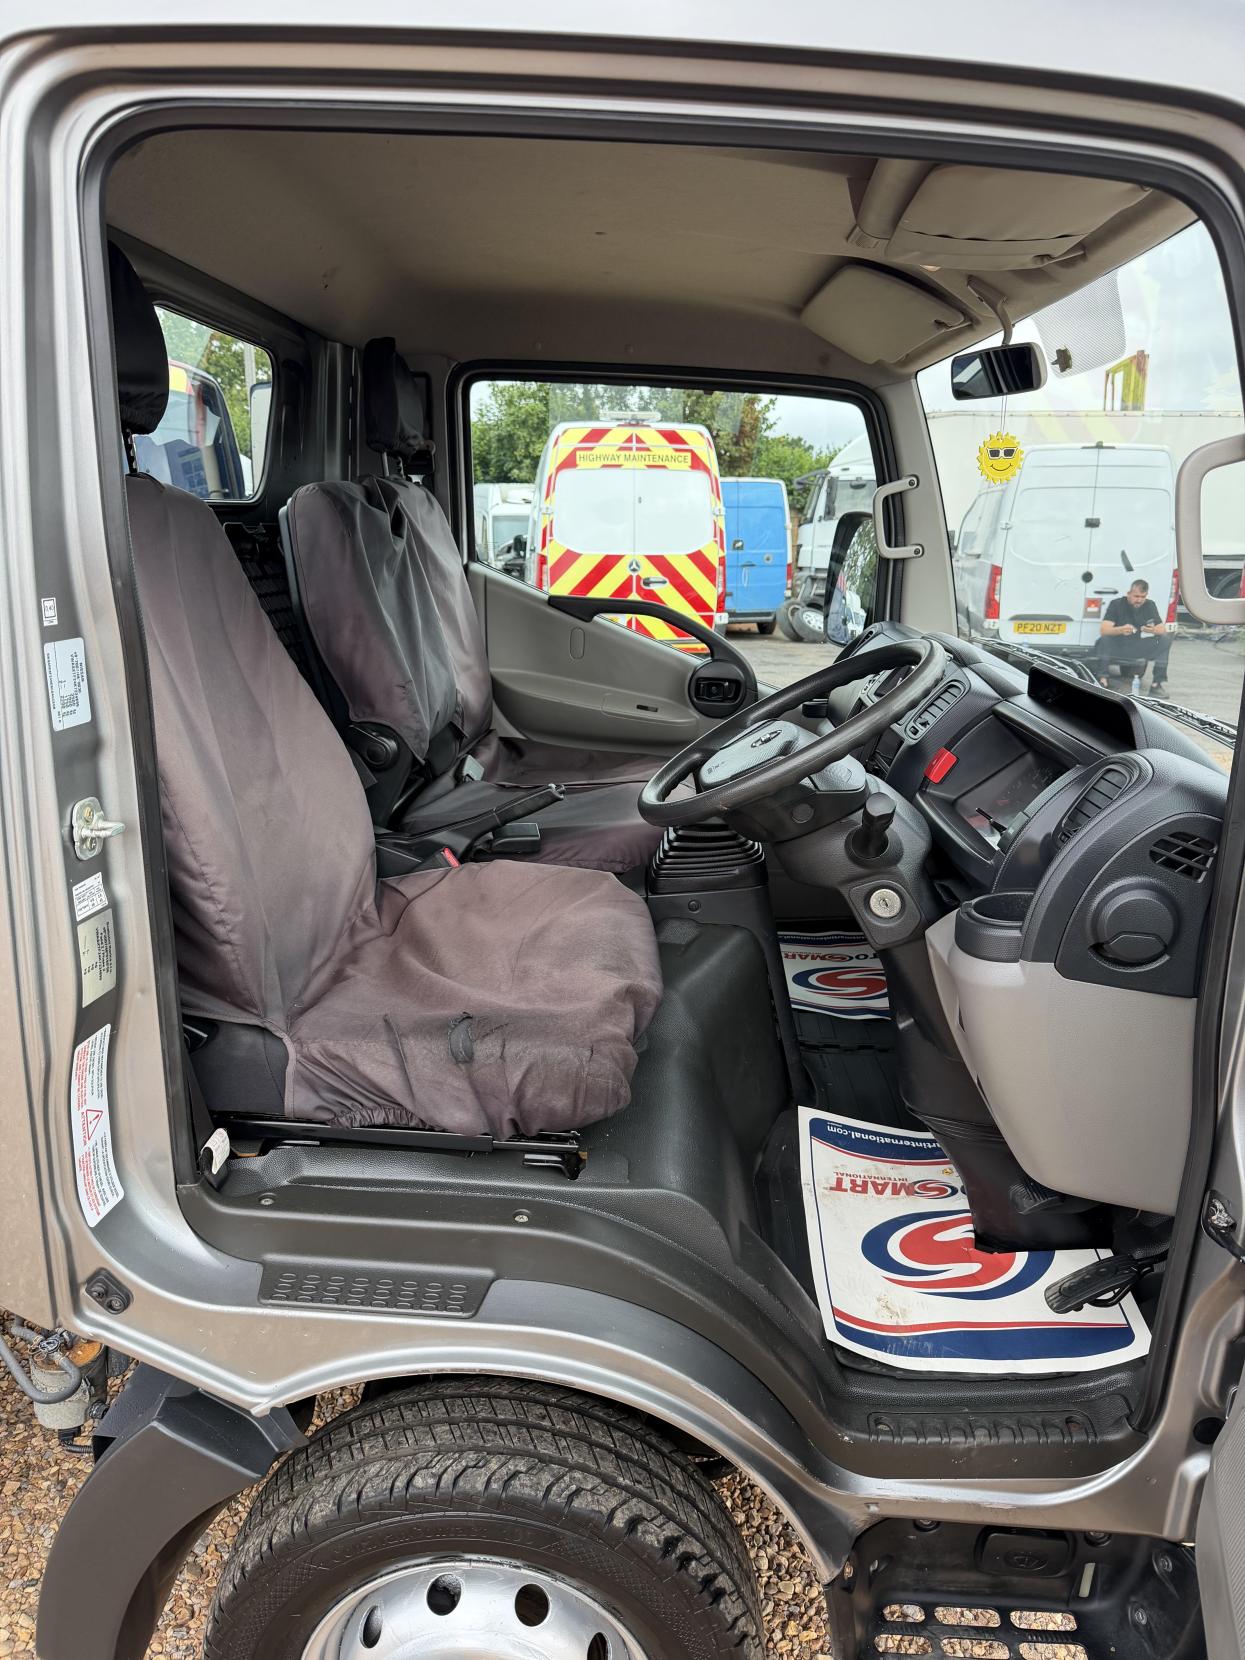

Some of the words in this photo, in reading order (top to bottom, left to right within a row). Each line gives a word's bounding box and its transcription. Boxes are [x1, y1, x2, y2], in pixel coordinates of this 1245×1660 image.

[578, 453, 621, 462] HIGHWAY
[624, 453, 689, 463] MAINTENANCE
[1016, 623, 1042, 632] PF20
[1043, 623, 1062, 633] NZT
[833, 1171, 909, 1182] INTERNATIONAL
